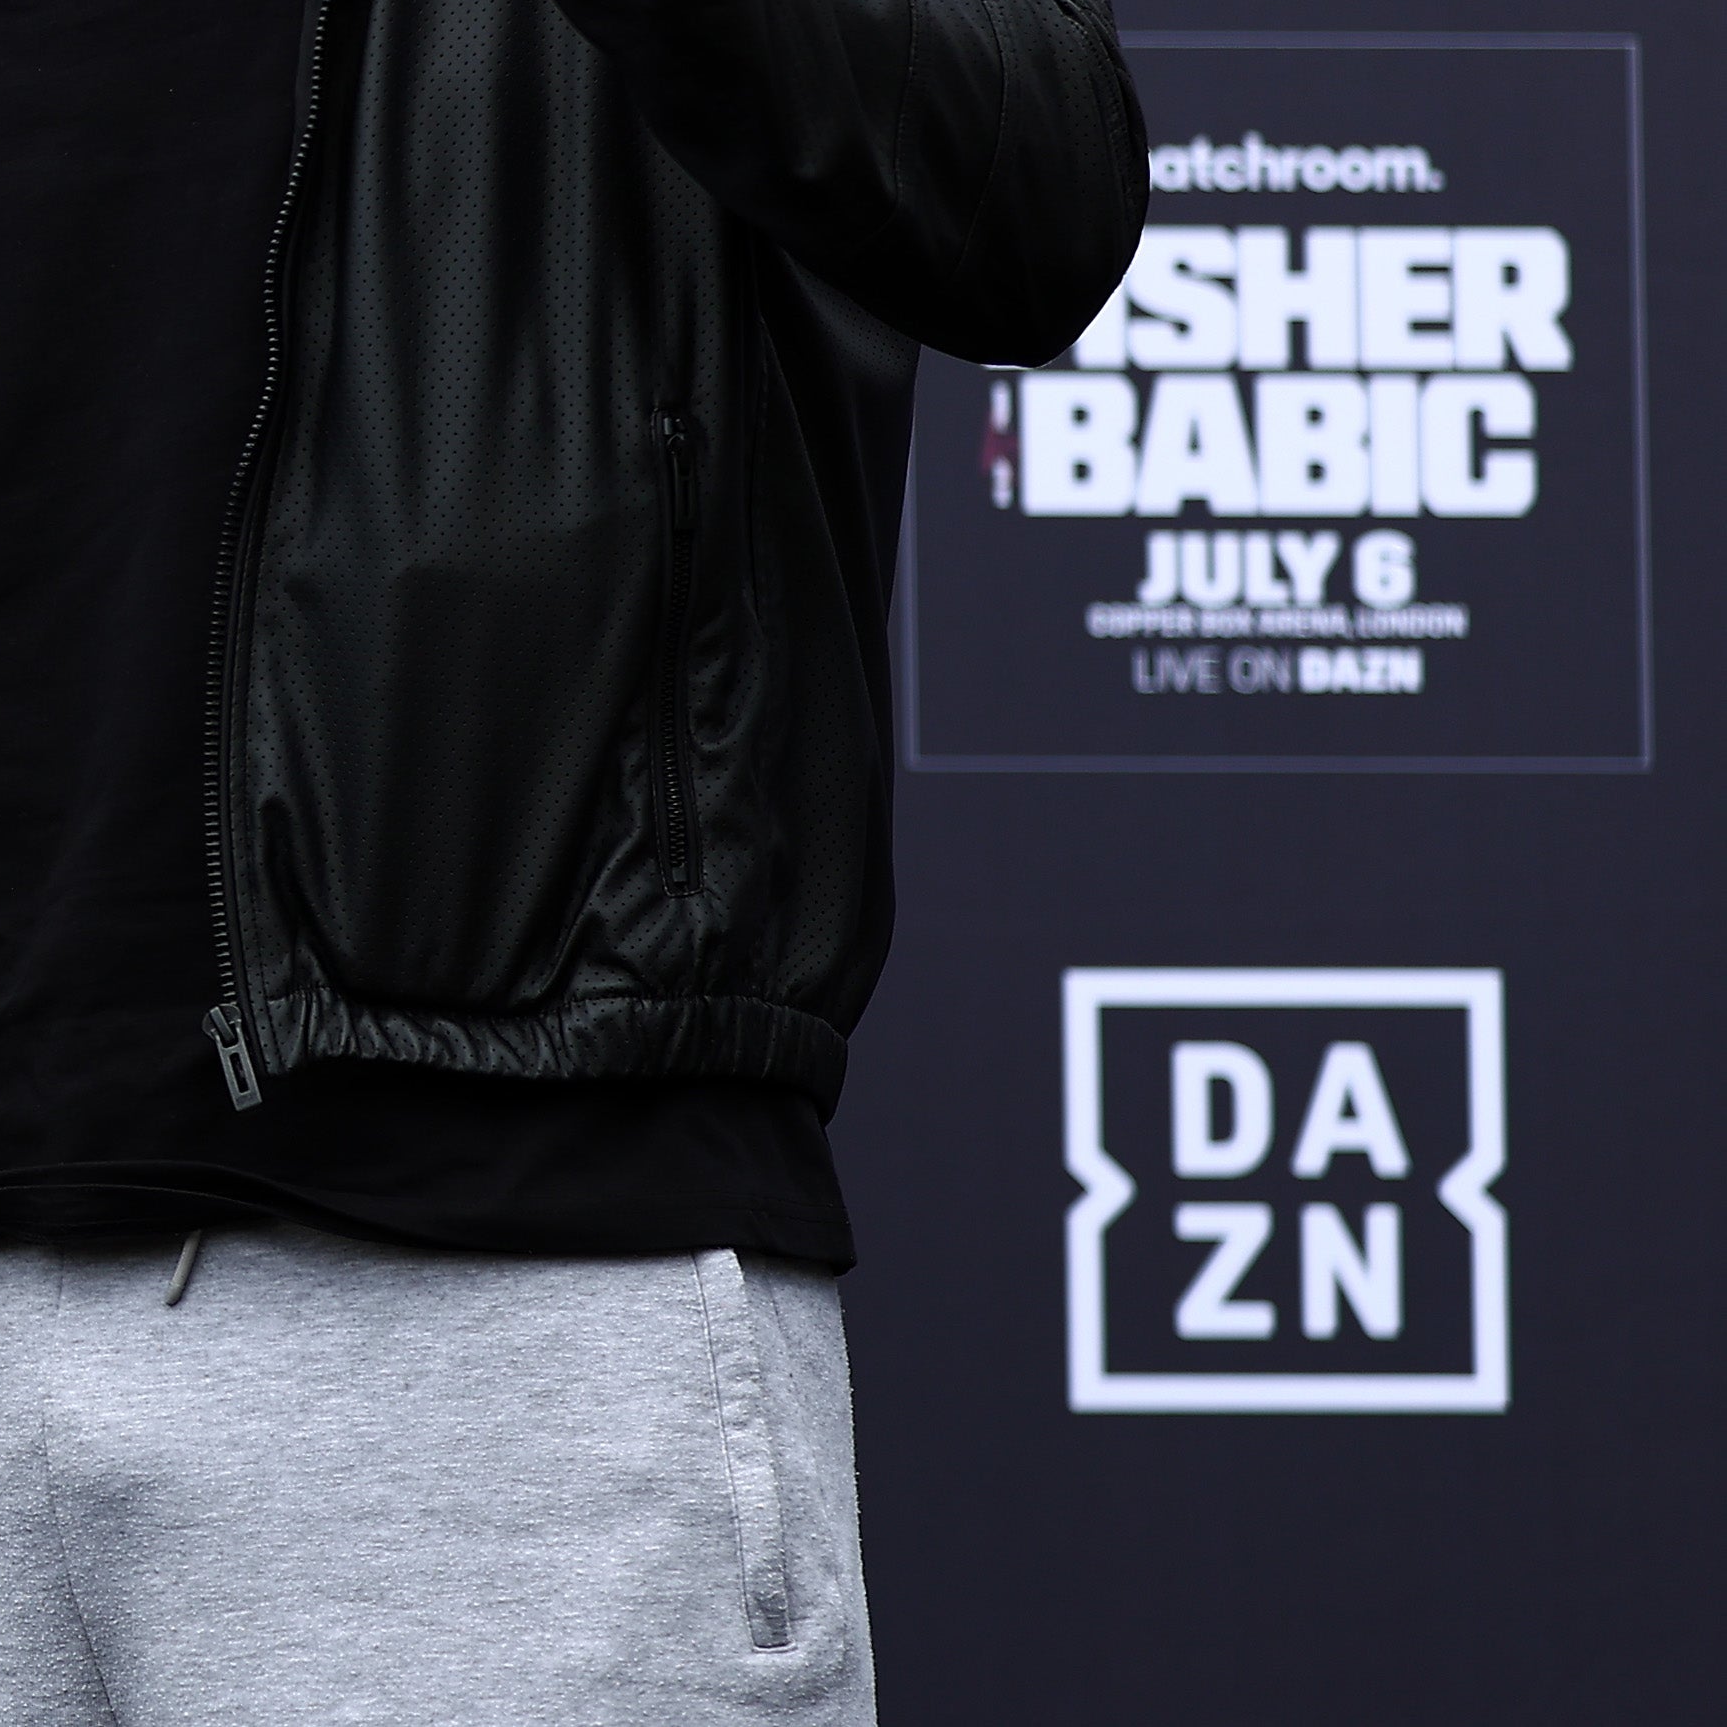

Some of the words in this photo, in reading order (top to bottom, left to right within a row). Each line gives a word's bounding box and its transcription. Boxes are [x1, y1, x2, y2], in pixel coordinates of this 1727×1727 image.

[1018, 372, 1537, 518] BABIC
[1136, 529, 1341, 607] JULY
[1352, 528, 1416, 609] 6
[1131, 646, 1224, 695] LIVE
[1228, 646, 1291, 695] ON
[1297, 646, 1424, 694] DAZN
[1170, 1040, 1410, 1179] DA
[1173, 1201, 1402, 1340] ZN
